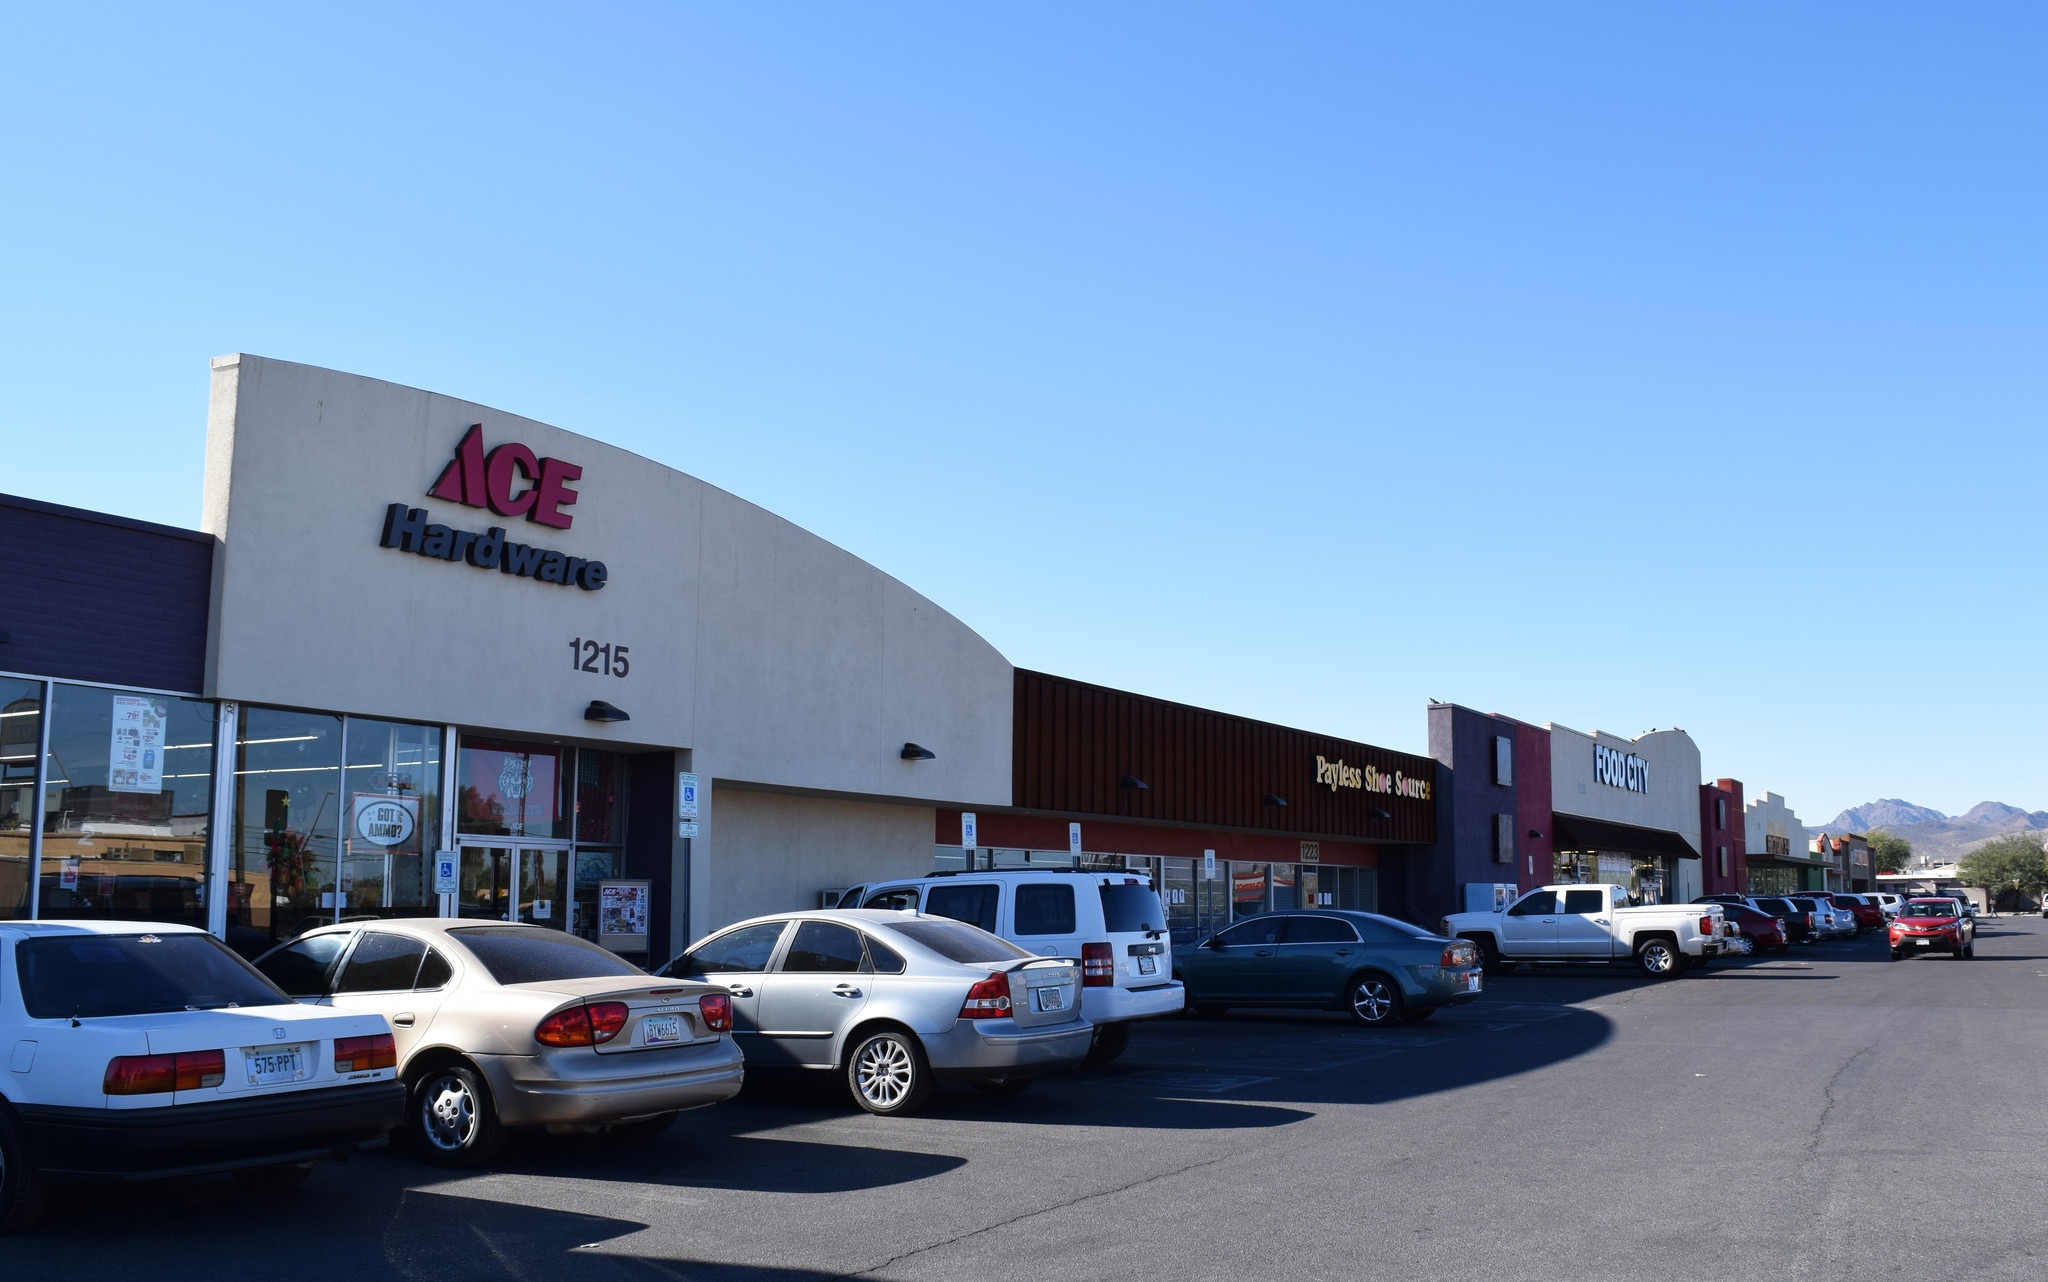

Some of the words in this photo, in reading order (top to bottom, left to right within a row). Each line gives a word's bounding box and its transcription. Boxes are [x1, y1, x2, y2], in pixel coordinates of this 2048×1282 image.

[426, 423, 583, 529] ACE
[379, 502, 608, 590] Hardware
[569, 637, 630, 678] 1215
[1316, 755, 1362, 792] Payless
[1365, 764, 1392, 794] Shoe
[1395, 770, 1431, 800] Source
[1593, 743, 1626, 788] FOOD
[1626, 754, 1650, 794] CITY
[368, 823, 403, 838] AMMO?
[377, 807, 395, 822] GOT
[1301, 843, 1319, 860] 1223
